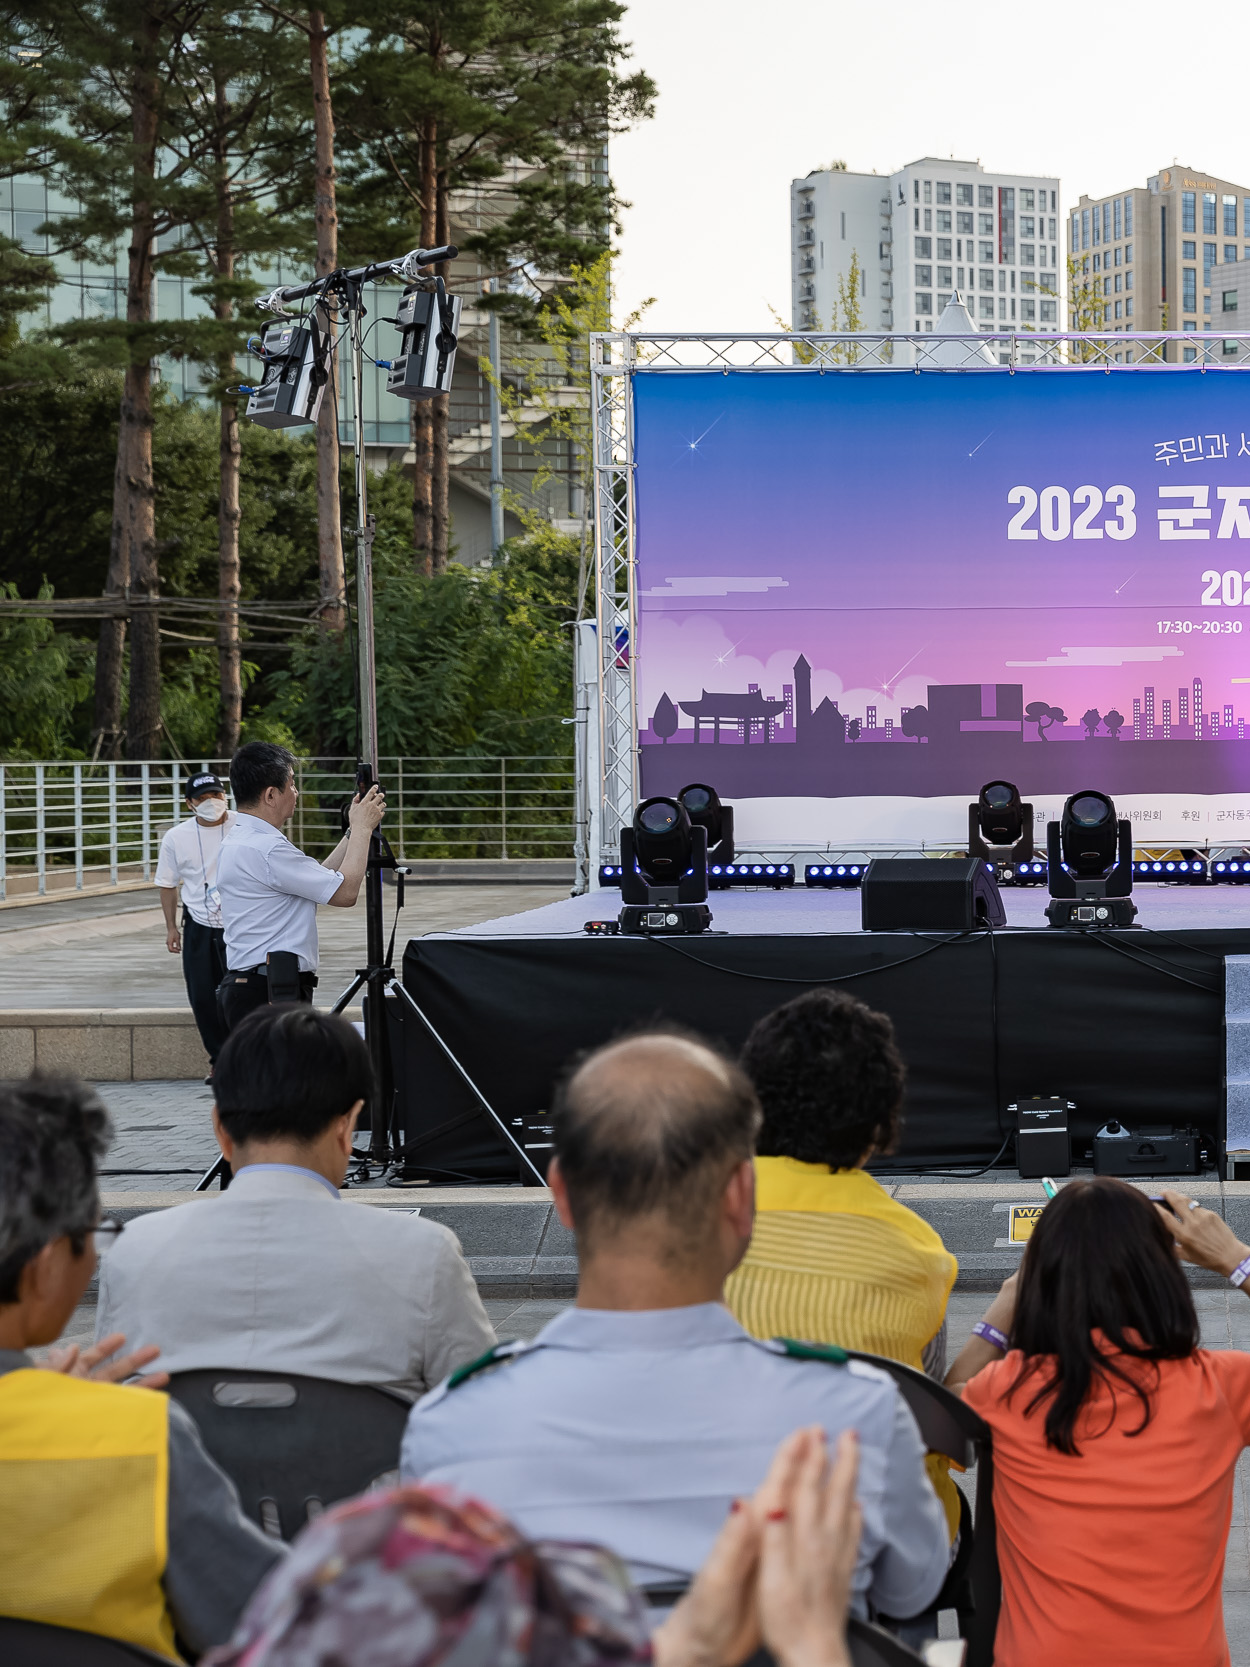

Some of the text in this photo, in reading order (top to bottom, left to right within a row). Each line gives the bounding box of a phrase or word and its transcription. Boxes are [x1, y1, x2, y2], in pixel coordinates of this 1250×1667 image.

[1154, 435, 1230, 466] 주민과
[1006, 485, 1137, 541] 2023
[1157, 620, 1242, 634] 17:30~20:30
[1033, 811, 1046, 822] 관
[1181, 810, 1200, 821] 후원
